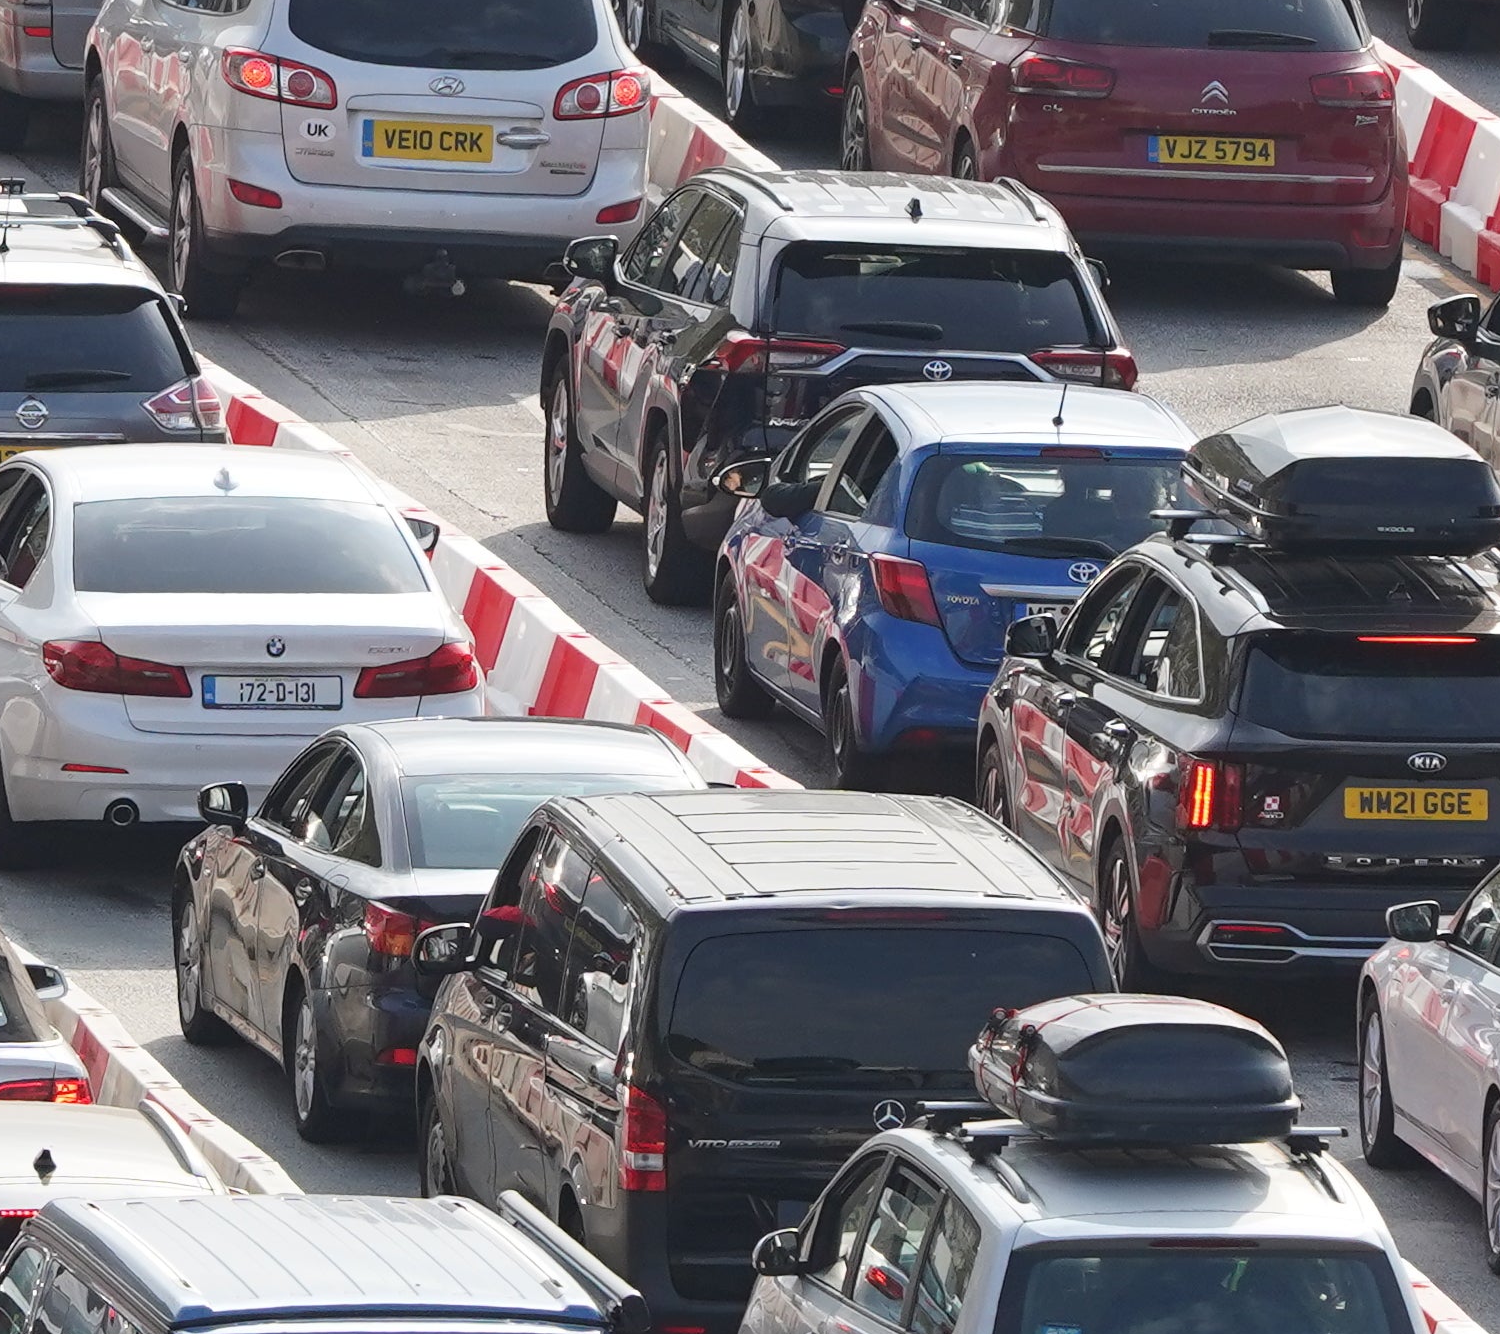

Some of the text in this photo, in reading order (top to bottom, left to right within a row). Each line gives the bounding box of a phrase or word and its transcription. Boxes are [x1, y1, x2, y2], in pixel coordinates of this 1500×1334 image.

[306, 124, 329, 137] UK
[383, 128, 484, 153] VE10 CRK
[1166, 140, 1271, 163] VJZ 5794
[946, 595, 980, 606] TOYOTA
[240, 682, 315, 703] 172-D-131
[1414, 756, 1441, 769] KIA
[1360, 791, 1472, 815] WM21 GGE
[687, 1139, 727, 1148] VITO
